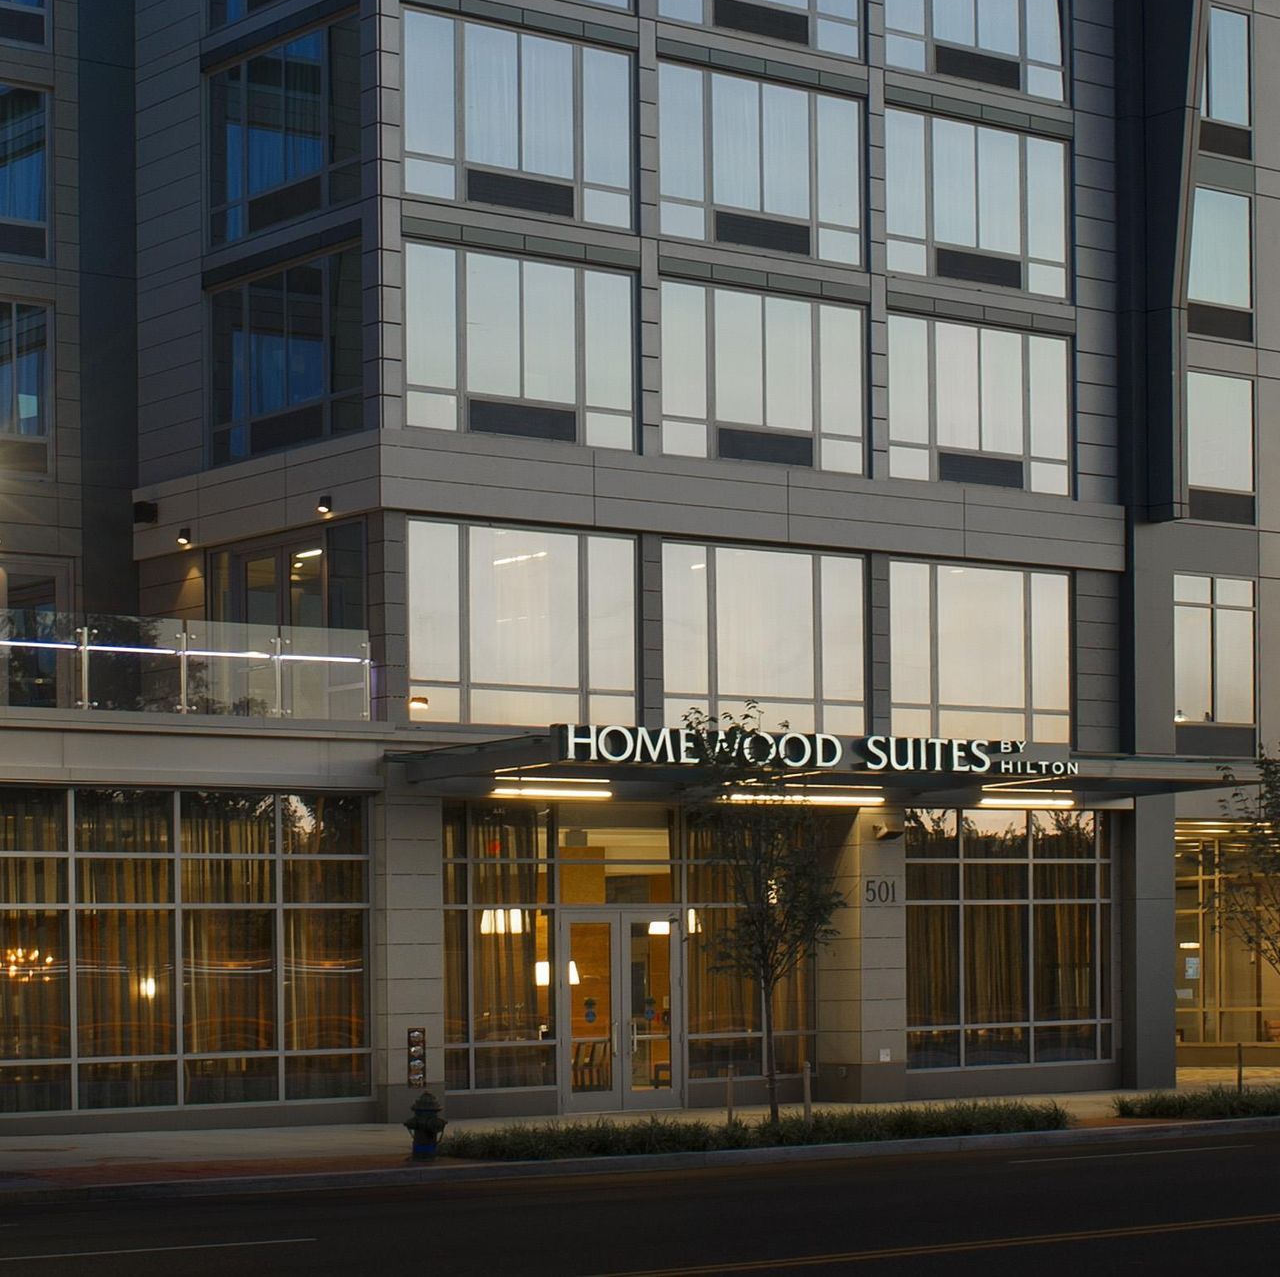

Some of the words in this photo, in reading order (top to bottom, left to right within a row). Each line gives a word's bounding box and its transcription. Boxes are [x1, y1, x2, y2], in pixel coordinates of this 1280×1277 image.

[867, 735, 991, 773] SUITES
[1000, 740, 1027, 753] BY
[1000, 760, 1079, 775] HILTON
[865, 880, 896, 903] 501
